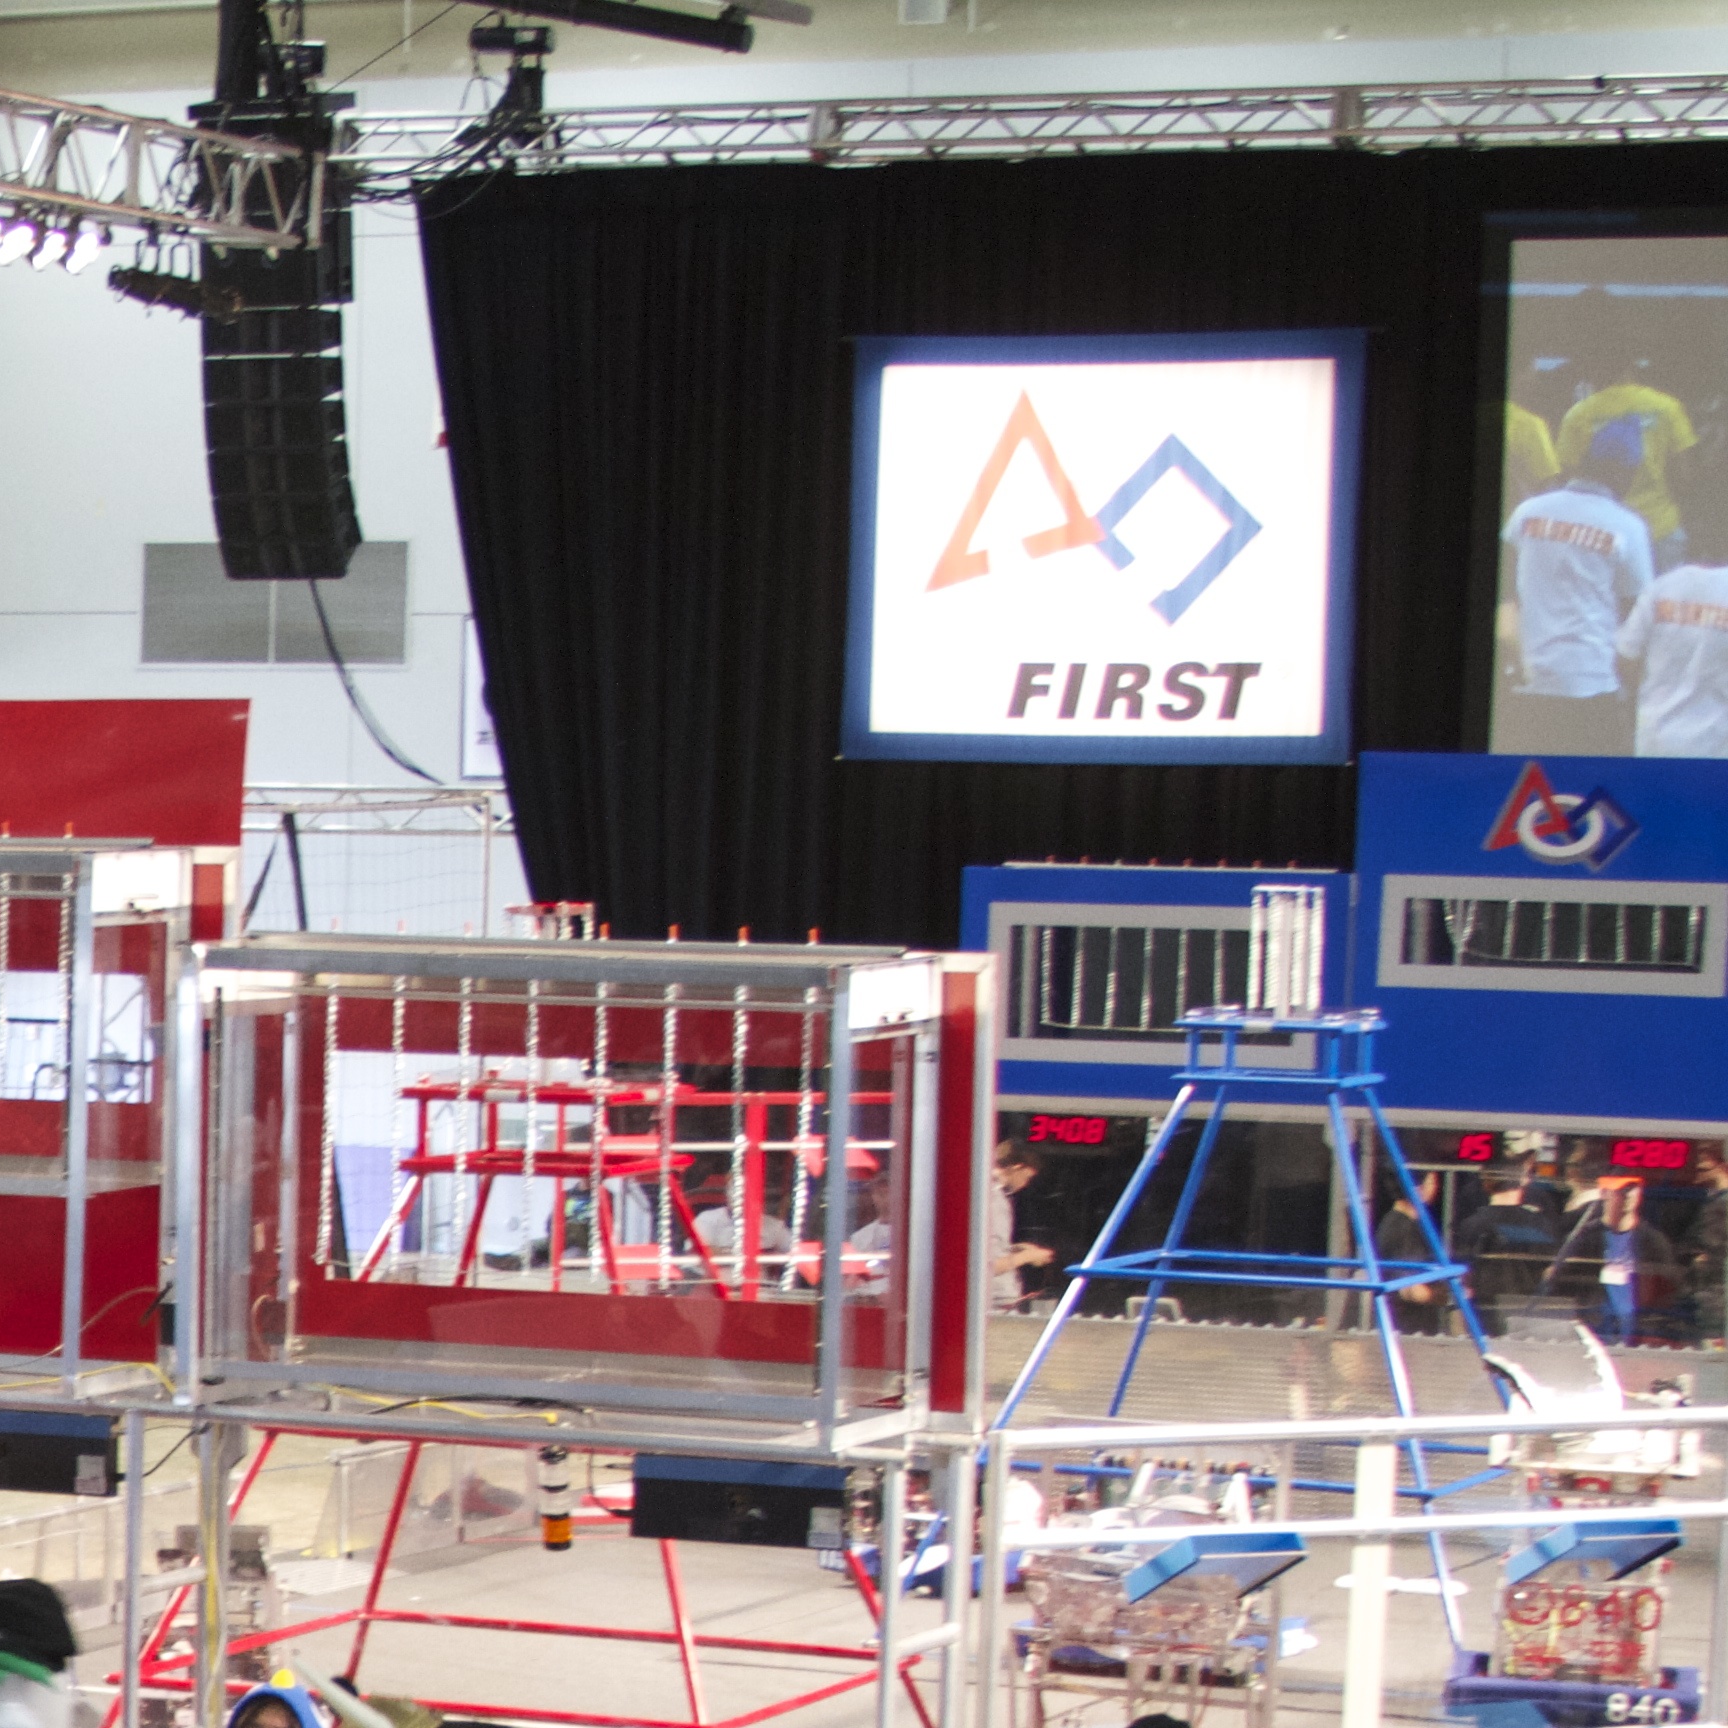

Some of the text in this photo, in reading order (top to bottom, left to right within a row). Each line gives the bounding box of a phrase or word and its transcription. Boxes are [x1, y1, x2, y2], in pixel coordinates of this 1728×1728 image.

[1006, 661, 1261, 721] FIRST
[1029, 1114, 1108, 1146] 3408
[1610, 1138, 1691, 1170] 1280
[1605, 1692, 1682, 1725] 840
